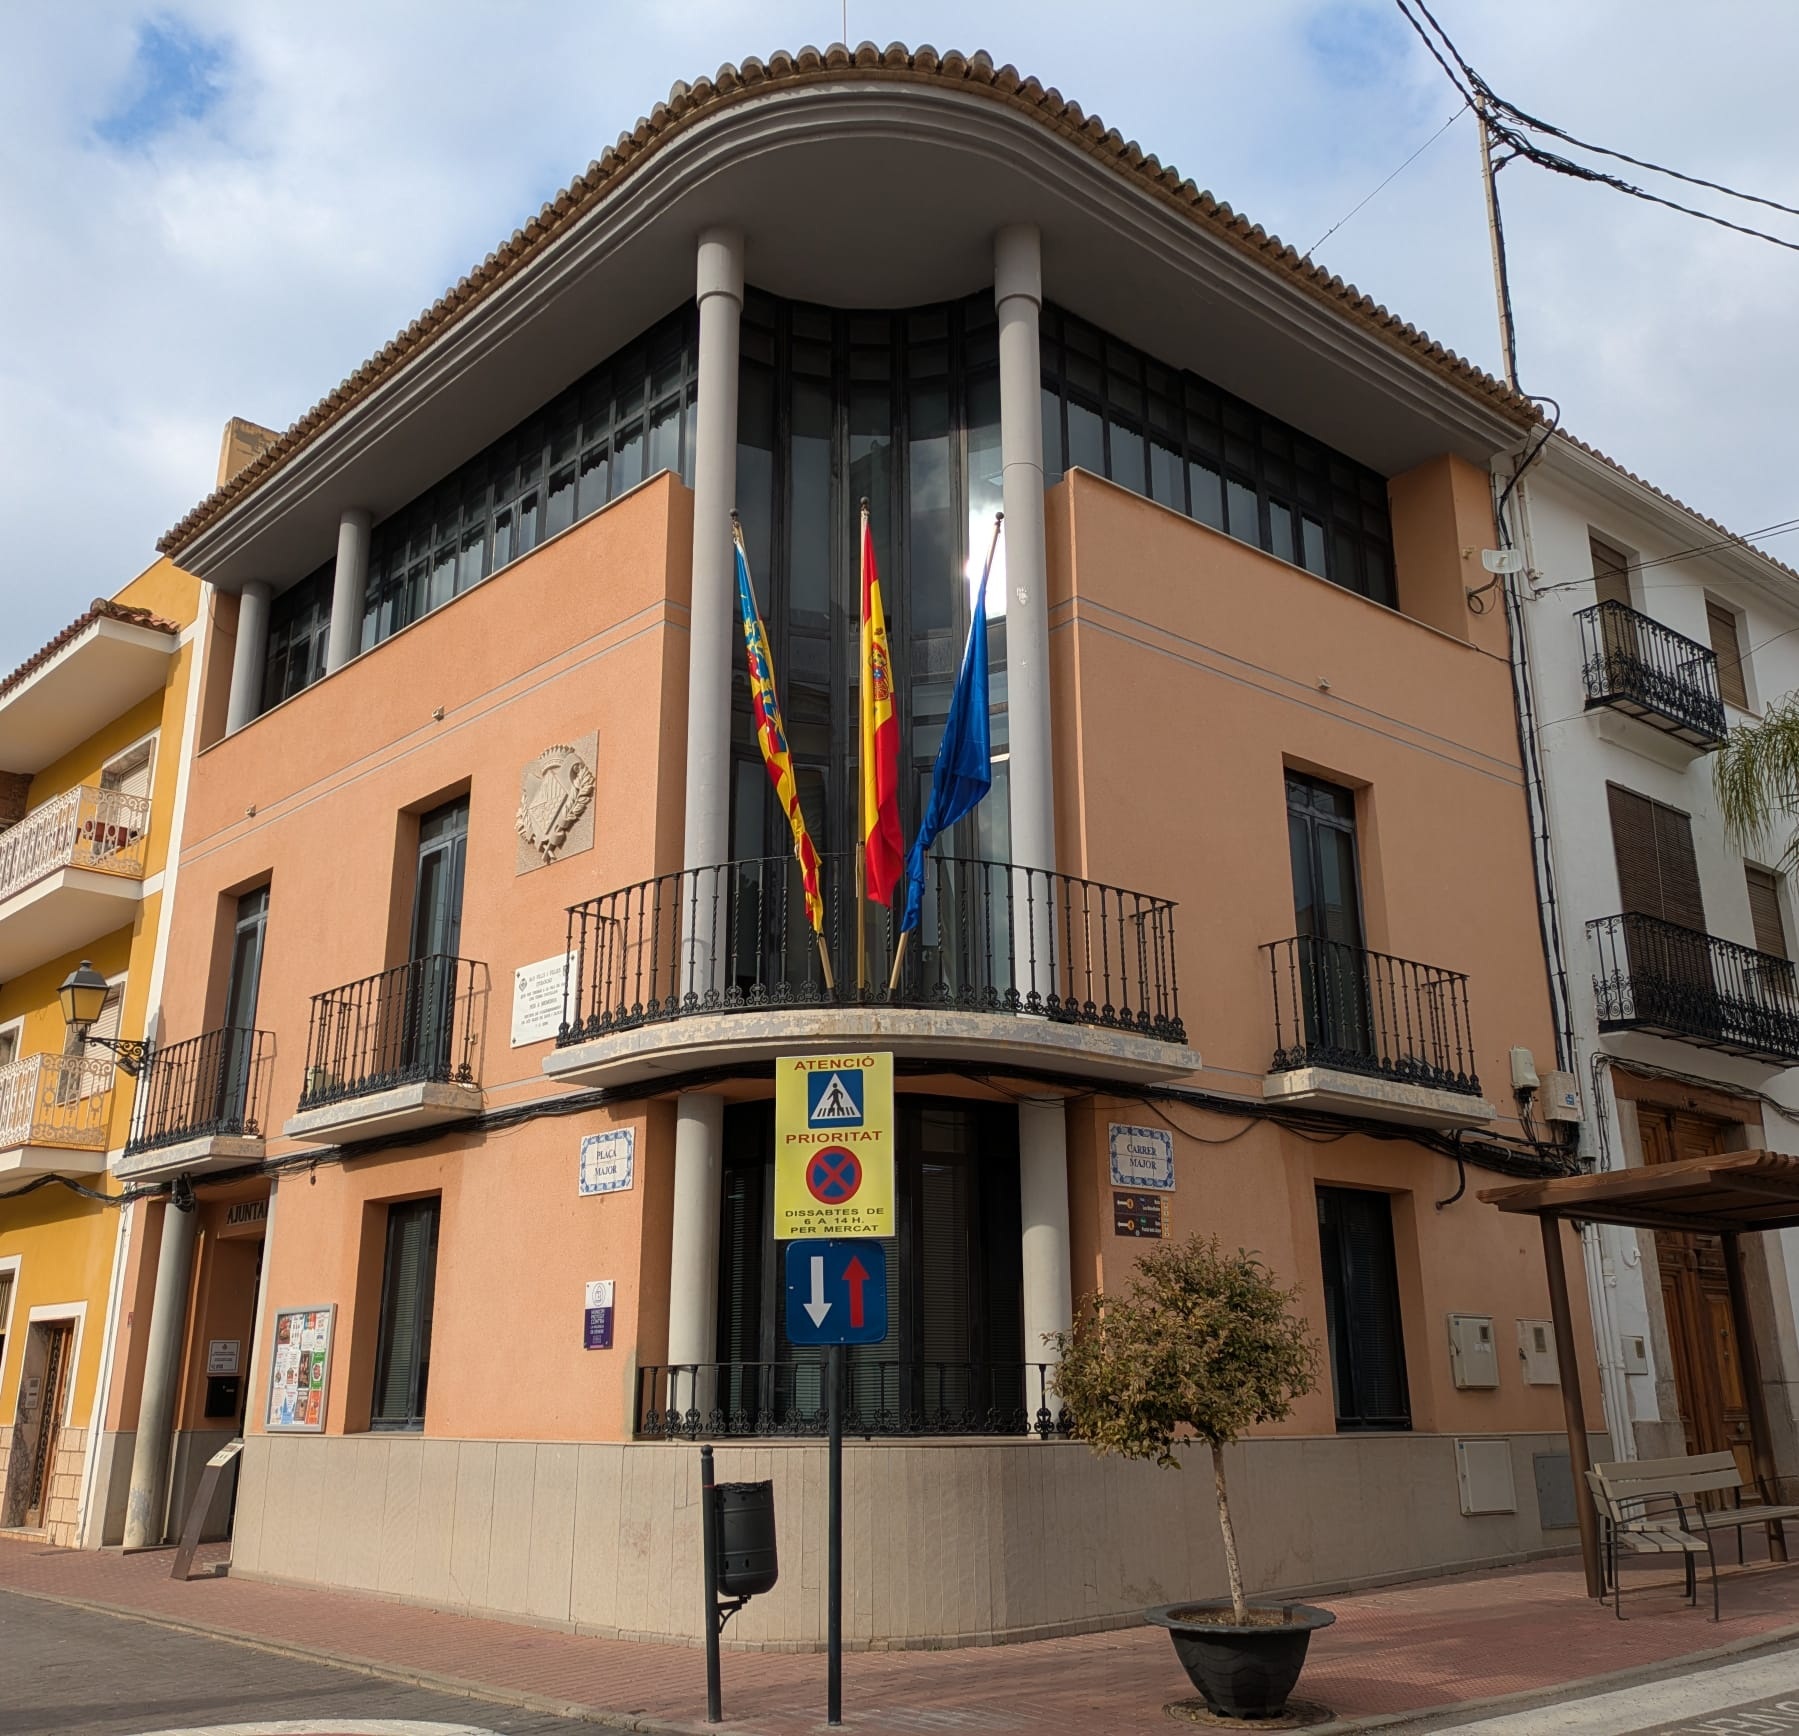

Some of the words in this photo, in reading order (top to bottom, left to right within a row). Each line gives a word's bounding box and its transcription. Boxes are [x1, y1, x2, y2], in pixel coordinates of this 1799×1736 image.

[794, 1056, 875, 1071] ATENCIÓ
[785, 1131, 882, 1144] PRIORITAT
[1127, 1144, 1156, 1155] CARRER
[596, 1150, 617, 1160] PLAÇA
[1129, 1159, 1157, 1169] MAJOR
[595, 1165, 617, 1175] MAJOR
[226, 1200, 268, 1224] AJUNTA
[785, 1208, 859, 1217] DISSABTES
[790, 1226, 816, 1234] PER
[824, 1225, 879, 1233] MERCAT
